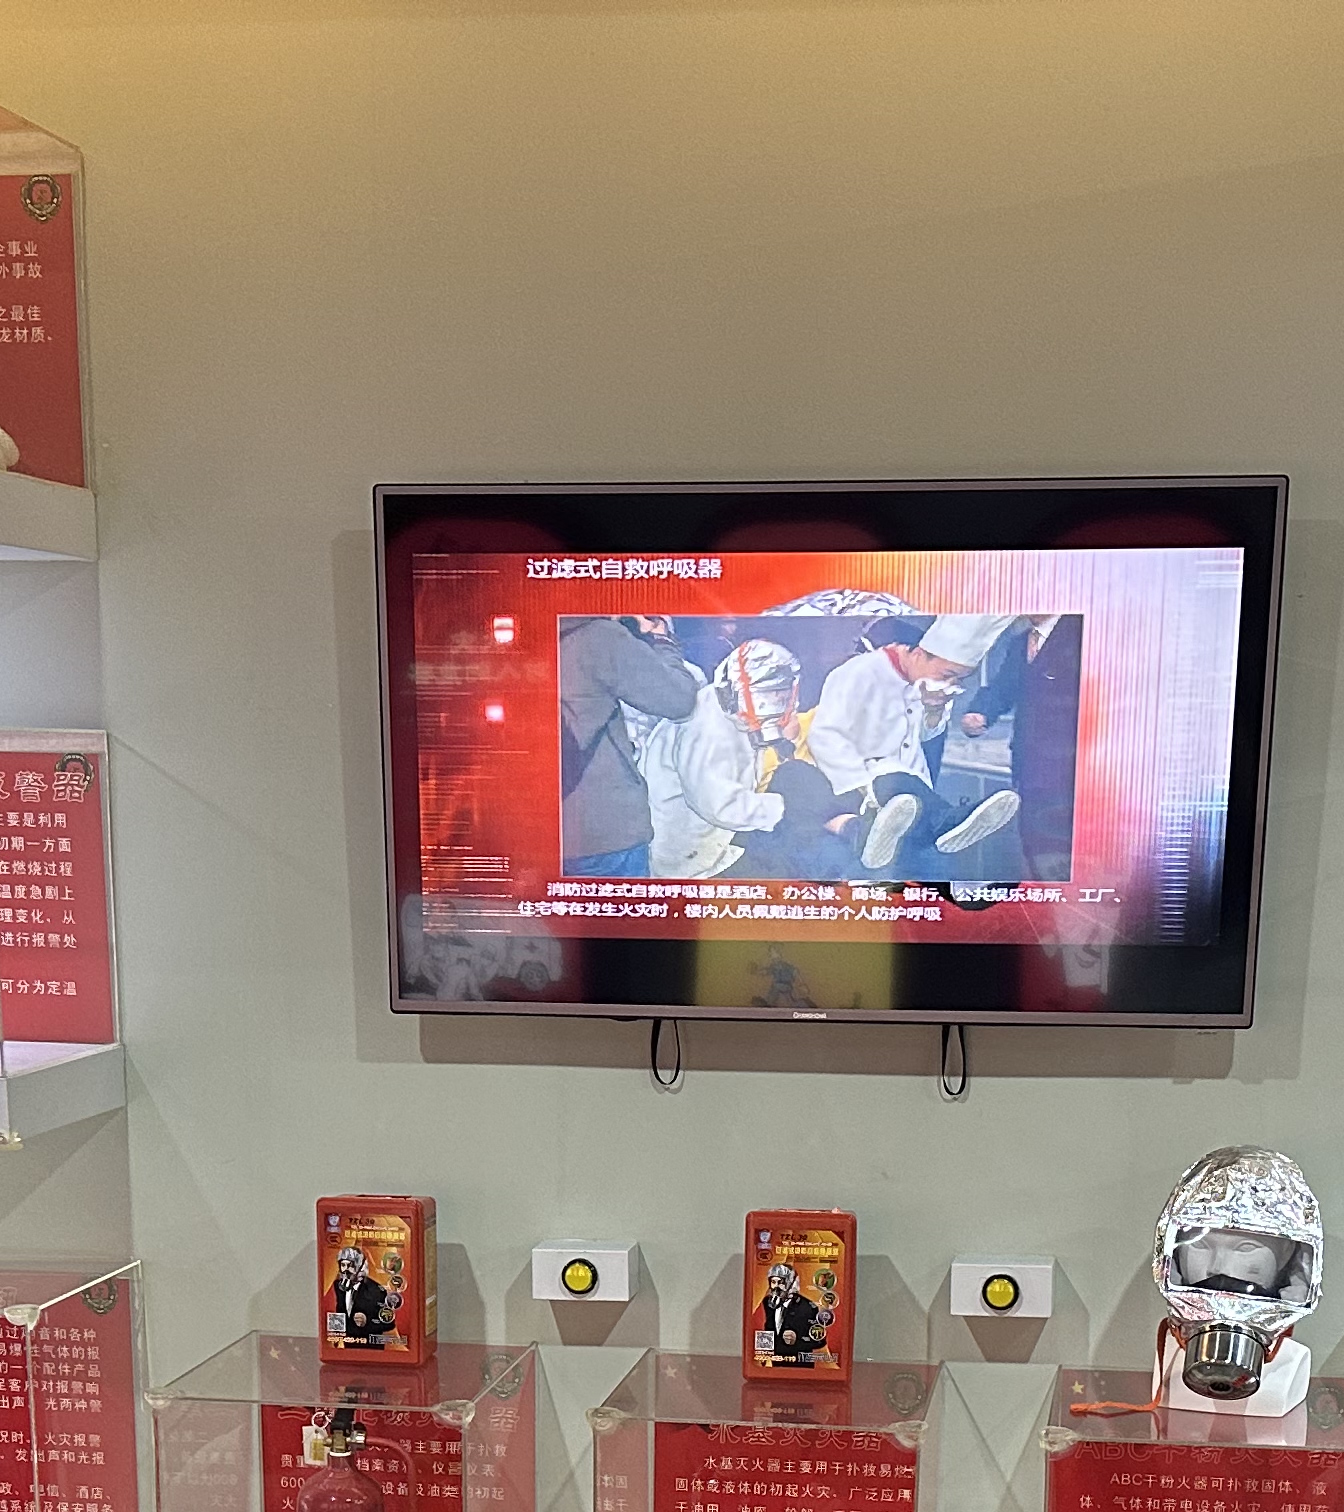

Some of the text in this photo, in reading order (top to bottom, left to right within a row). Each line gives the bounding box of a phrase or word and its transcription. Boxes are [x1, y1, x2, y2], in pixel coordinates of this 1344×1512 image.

[526, 558, 722, 579] 过滤式自救呼吸器
